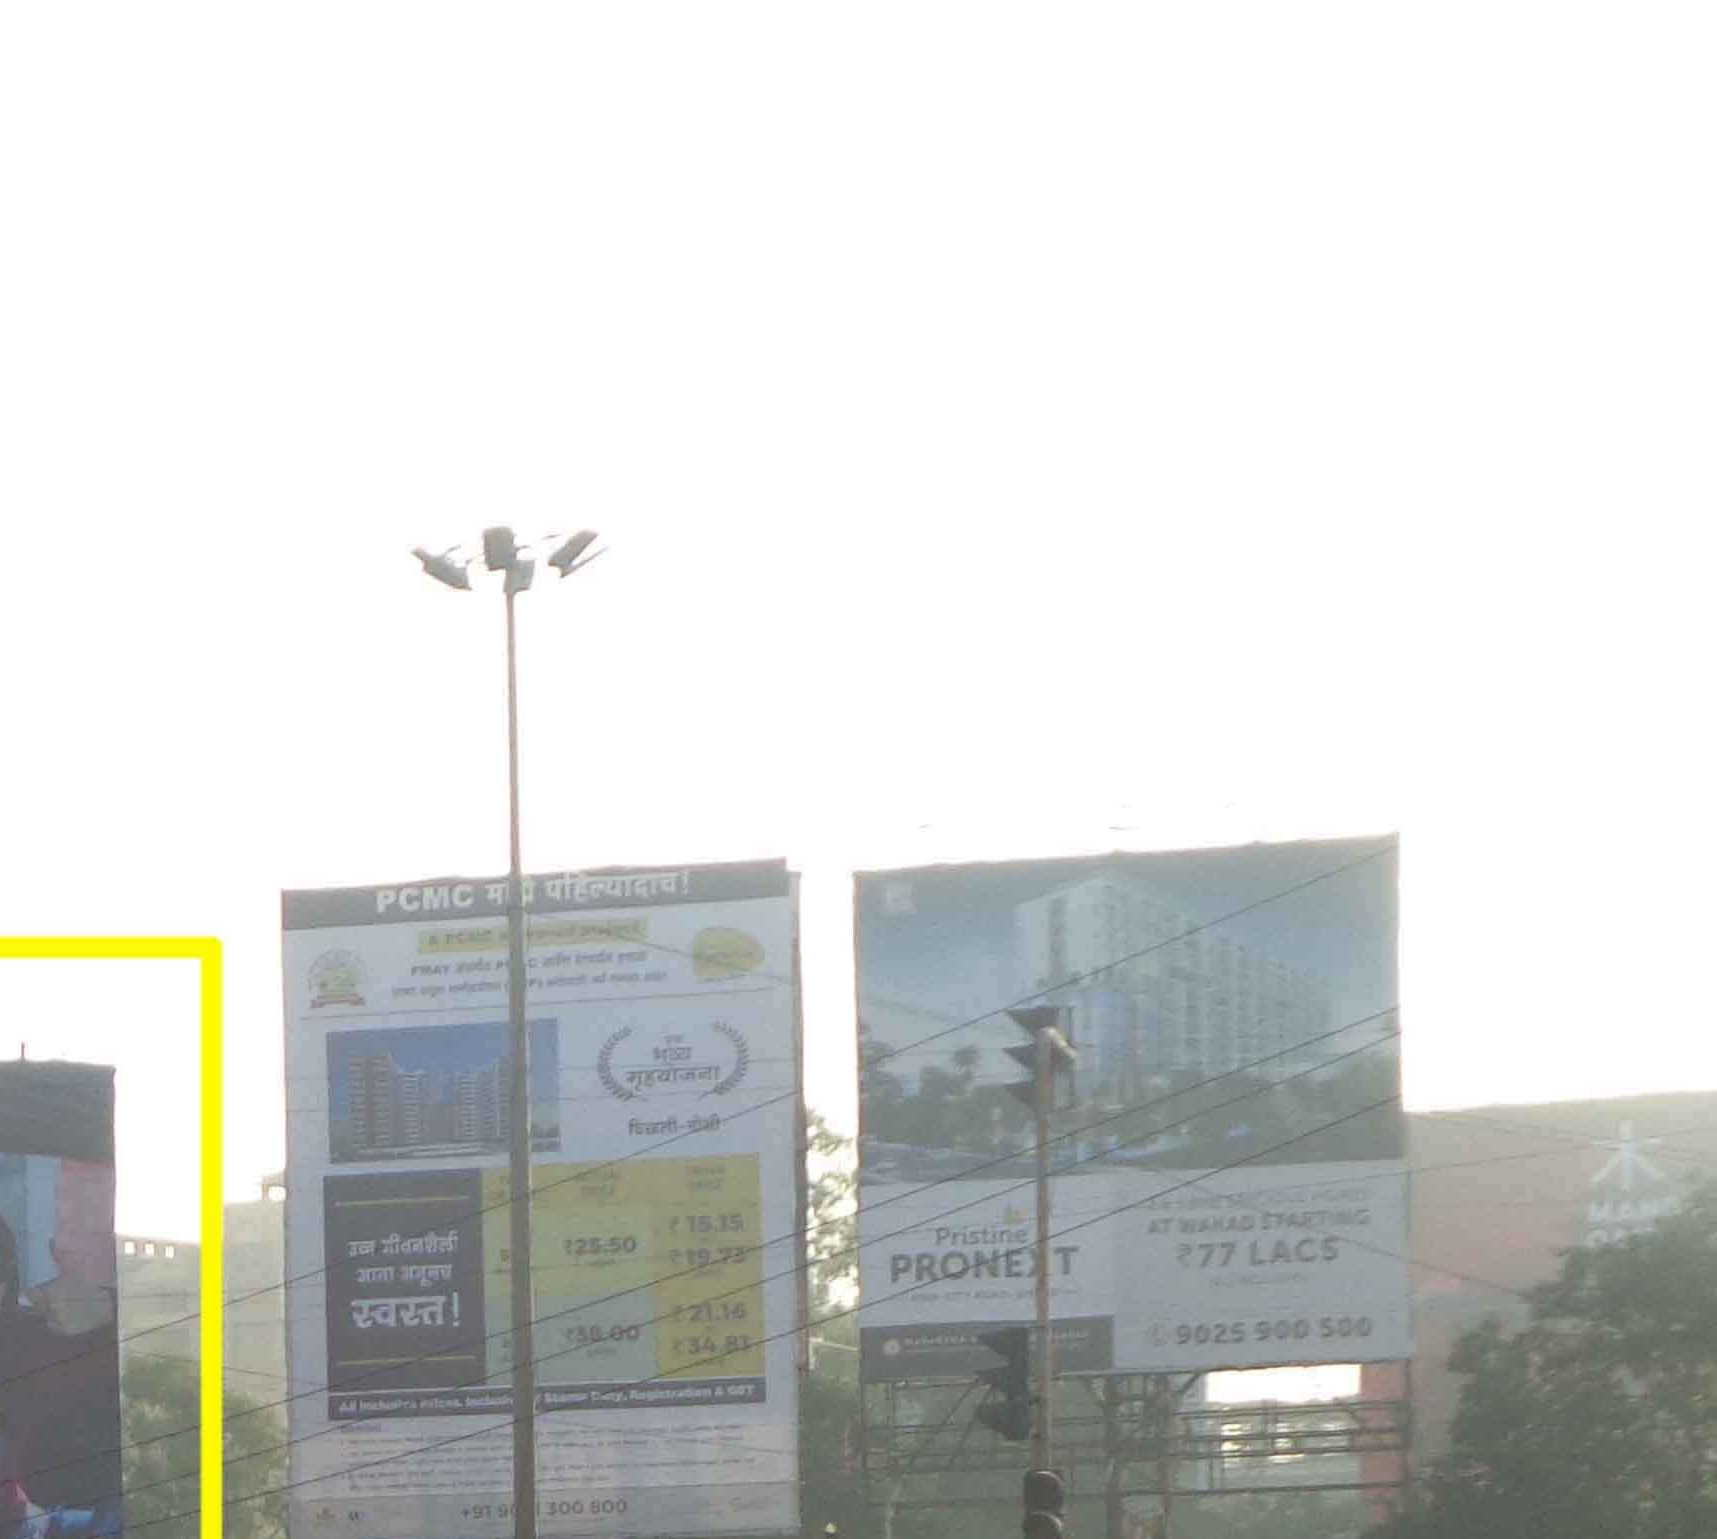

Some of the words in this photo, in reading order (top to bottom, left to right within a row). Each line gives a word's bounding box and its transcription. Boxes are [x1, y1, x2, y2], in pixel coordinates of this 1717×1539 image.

[376, 883, 475, 914] PCMC
[933, 1225, 1028, 1246] Pristine
[889, 1246, 1082, 1284] PRONET
[1176, 1241, 1237, 1269] ₹77
[1249, 1235, 1340, 1266] LACS
